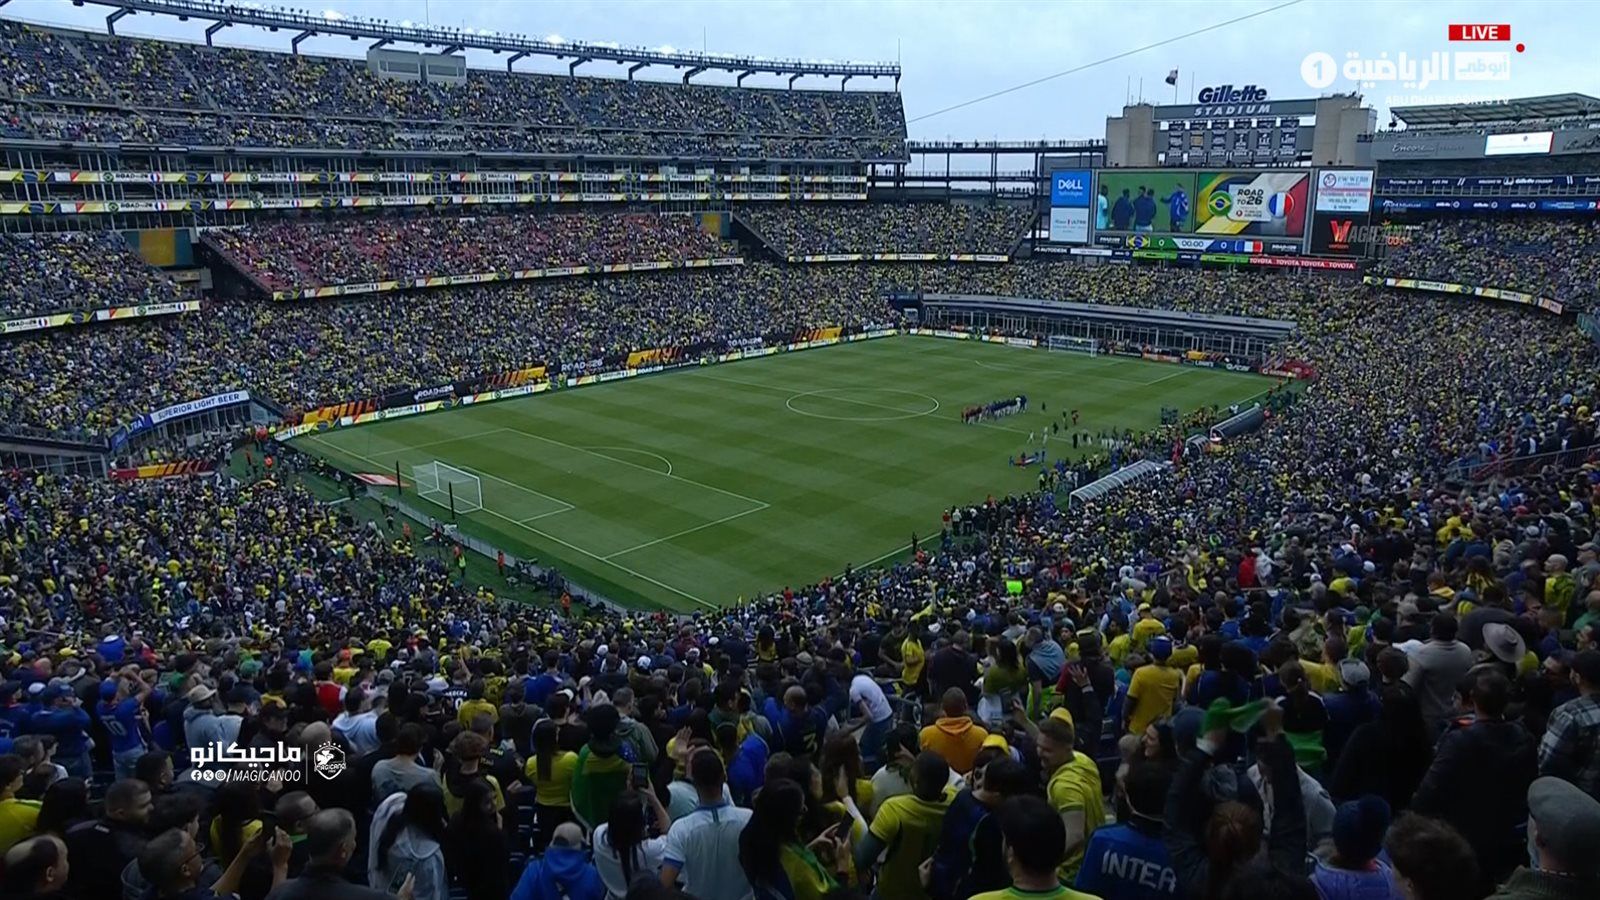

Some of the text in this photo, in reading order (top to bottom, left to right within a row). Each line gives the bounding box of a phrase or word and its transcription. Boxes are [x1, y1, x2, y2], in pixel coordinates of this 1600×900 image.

[1198, 85, 1267, 104] Gillette
[1194, 104, 1270, 116] STADIUM
[1058, 179, 1083, 190] DELL
[1237, 188, 1264, 196] ROAD
[1246, 195, 1264, 205] 26
[1220, 241, 1227, 249] 0
[1250, 257, 1272, 265] TOYOTA
[1276, 258, 1299, 266] TOYOTA
[1301, 259, 1325, 267] TOYOTA
[1329, 261, 1354, 269] TOYOTA
[561, 361, 586, 372] ROAD
[415, 388, 439, 399] ROAD
[157, 393, 239, 420] SUPERIOR LIGHT BEER
